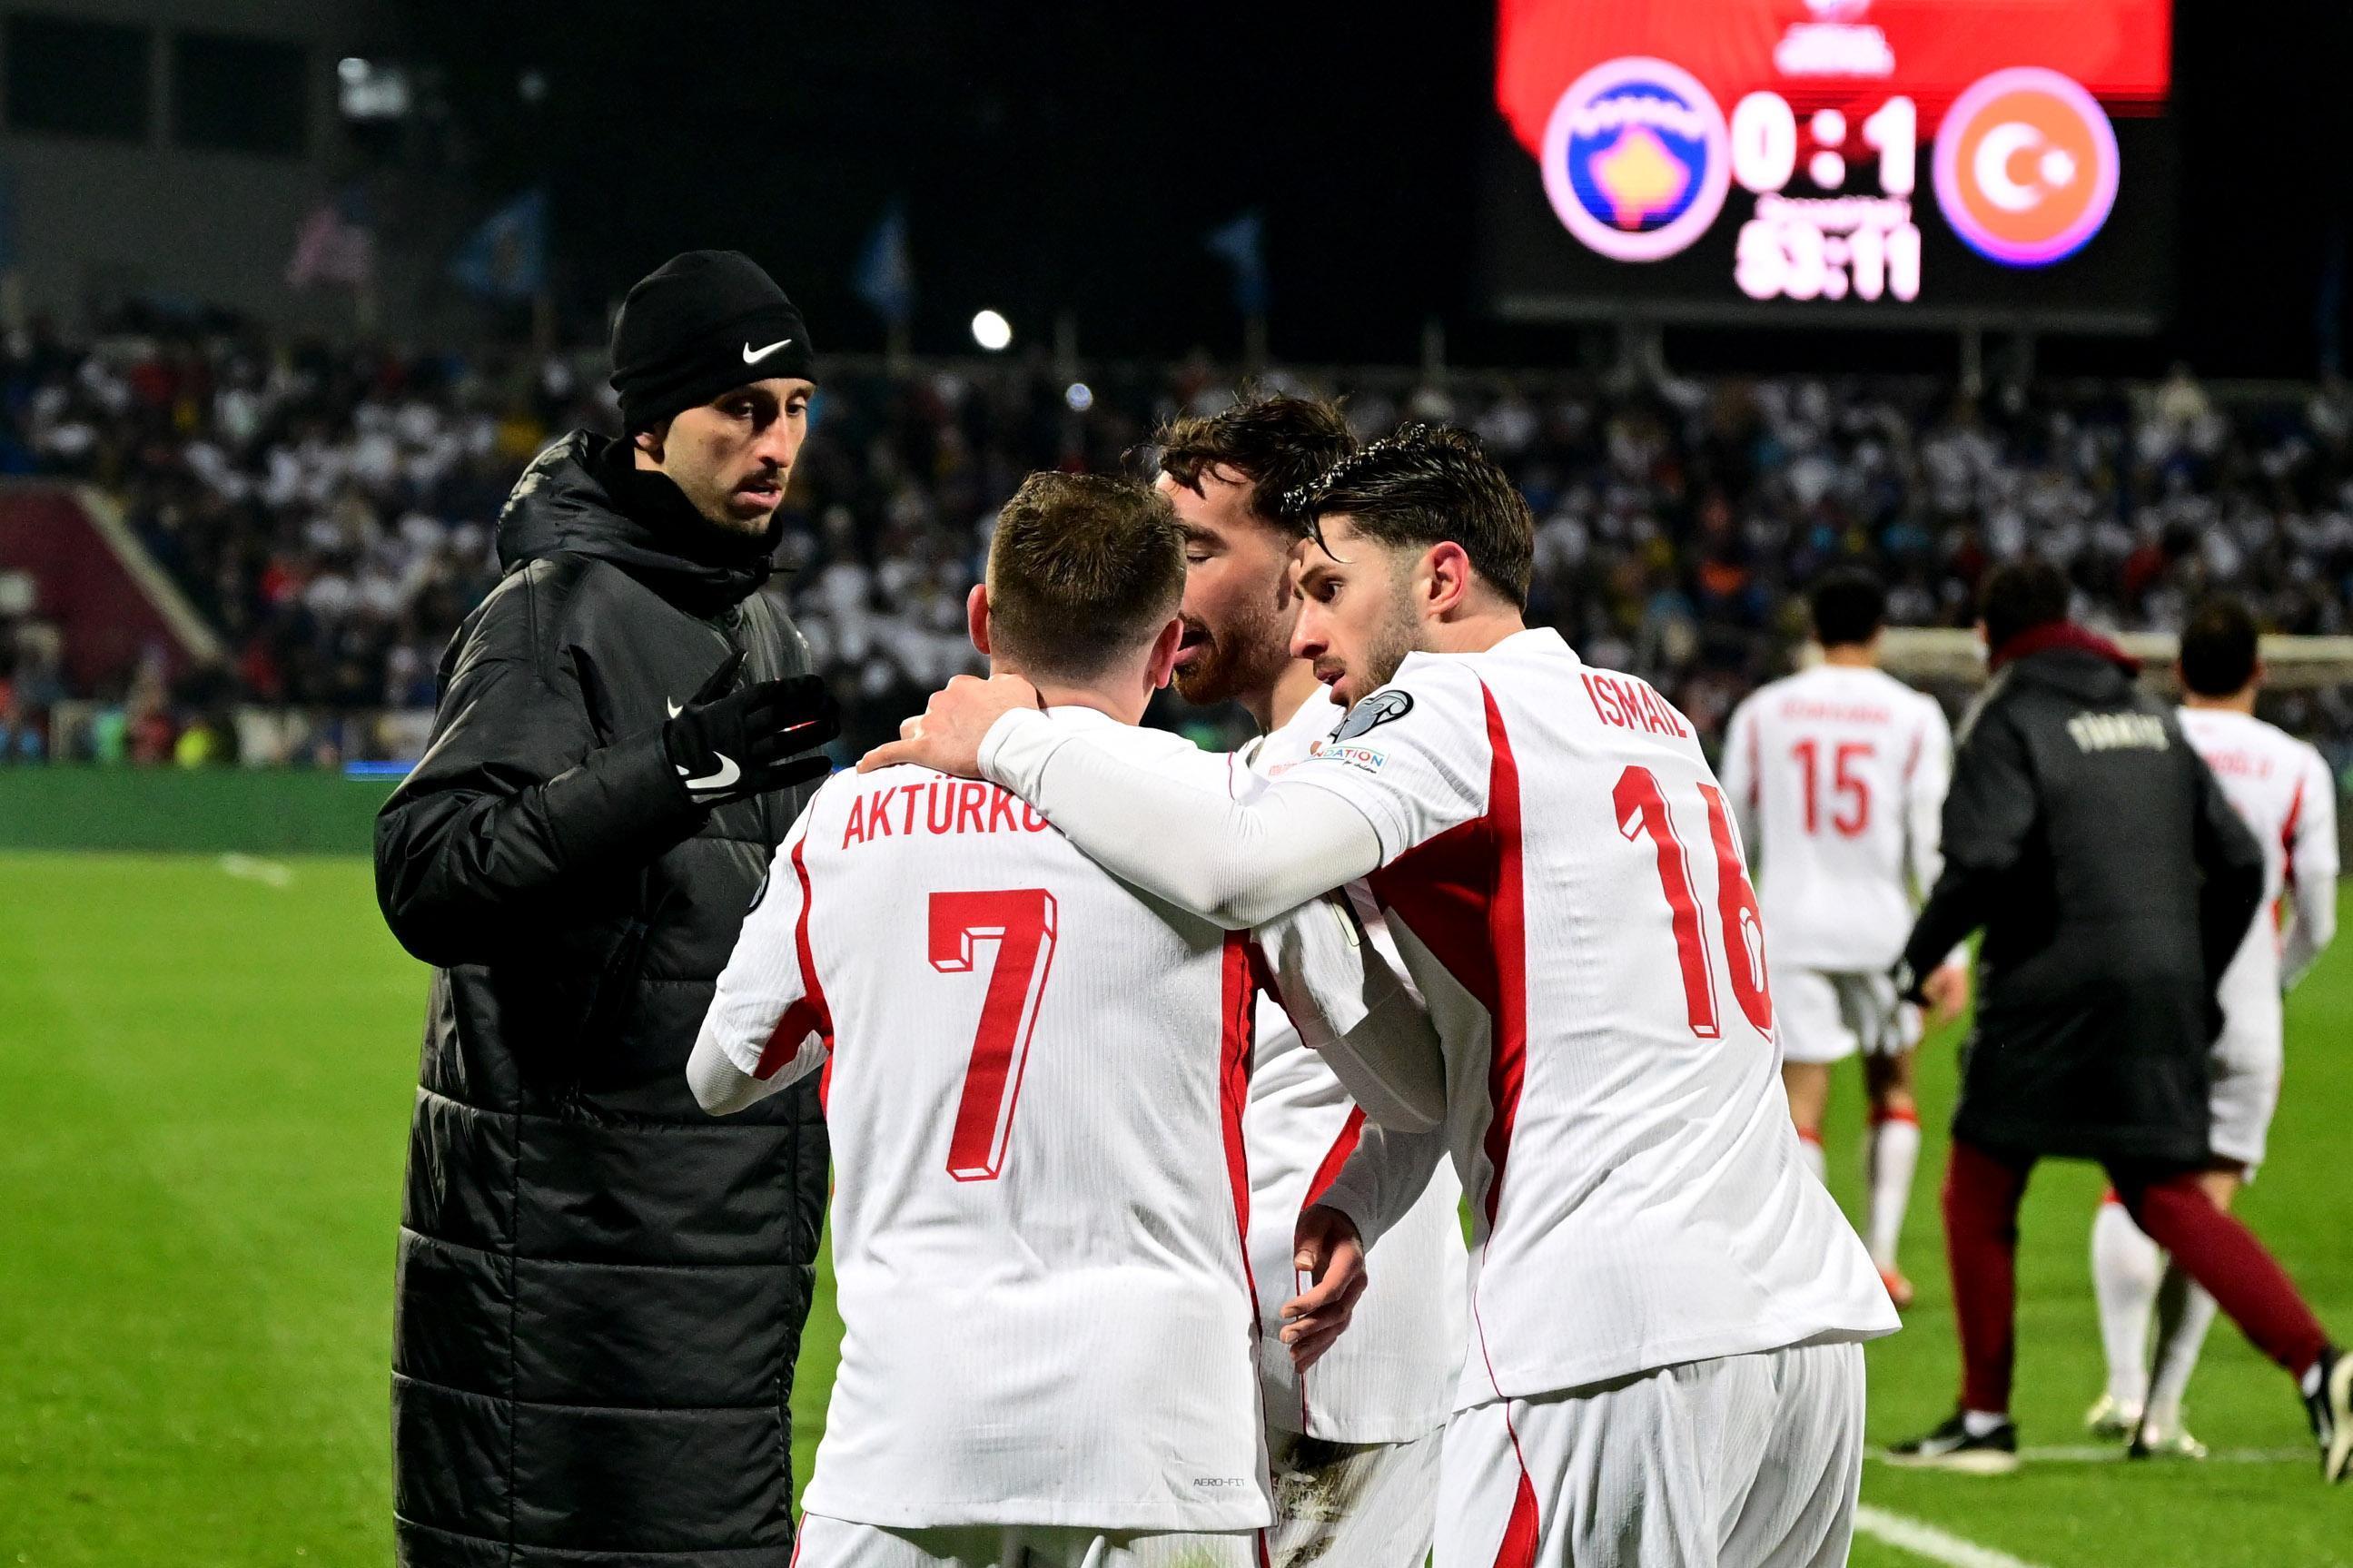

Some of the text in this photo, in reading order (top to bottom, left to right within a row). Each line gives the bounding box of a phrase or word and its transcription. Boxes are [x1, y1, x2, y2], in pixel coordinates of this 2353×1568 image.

[1580, 673, 1687, 738] ISMAIL
[1789, 737, 1877, 839] 15
[1612, 764, 1773, 1044] 16
[928, 888, 1057, 1182] 7
